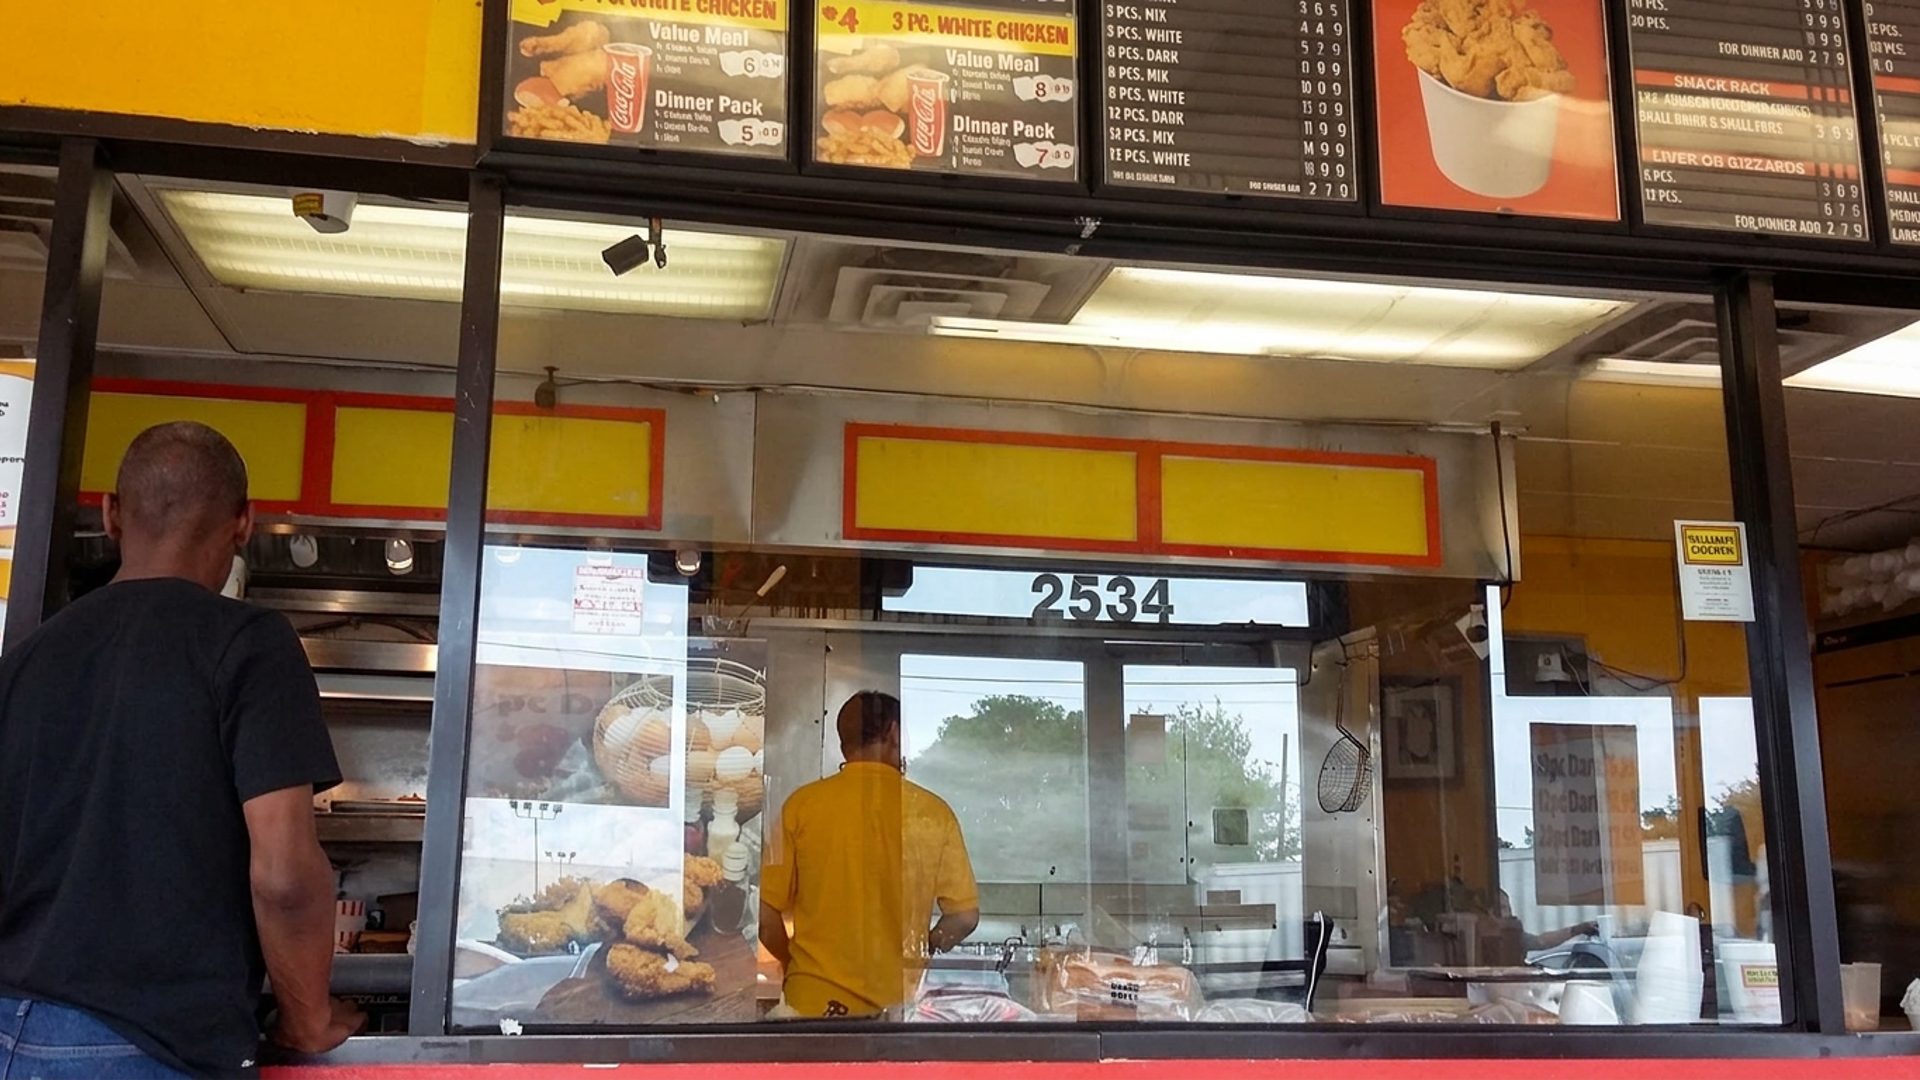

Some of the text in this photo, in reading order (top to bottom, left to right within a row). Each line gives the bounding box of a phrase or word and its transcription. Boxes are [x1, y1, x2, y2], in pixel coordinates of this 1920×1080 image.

[1116, 5, 1142, 20] PCS.
[649, 22, 700, 43] Value
[893, 11, 903, 31] 3
[908, 12, 934, 33] PC.
[937, 15, 992, 38] WHITE
[997, 21, 1069, 45] CHICKEN
[1116, 26, 1142, 41] PCS.
[1145, 28, 1183, 44] WHITE
[1118, 46, 1144, 61] PCS.
[1146, 48, 1179, 64] DARK
[1719, 42, 1739, 56] FOR
[946, 48, 1039, 72] Value Meal
[655, 90, 714, 112] Dinner
[719, 95, 763, 116] Pack
[1108, 86, 1185, 105] 8 PCS. WHITE
[1123, 107, 1149, 123] PCS.
[1152, 110, 1185, 126] DARK
[1013, 120, 1055, 139] Pack
[1124, 128, 1150, 143] PCS.
[1153, 130, 1175, 145] MIX
[1125, 148, 1151, 164] PCS.
[1152, 151, 1191, 167] WHITE
[1653, 149, 1699, 166] LIVER
[1653, 170, 1677, 183] PCS.
[1659, 190, 1683, 203] PCS.
[1032, 574, 1174, 624] 2534
